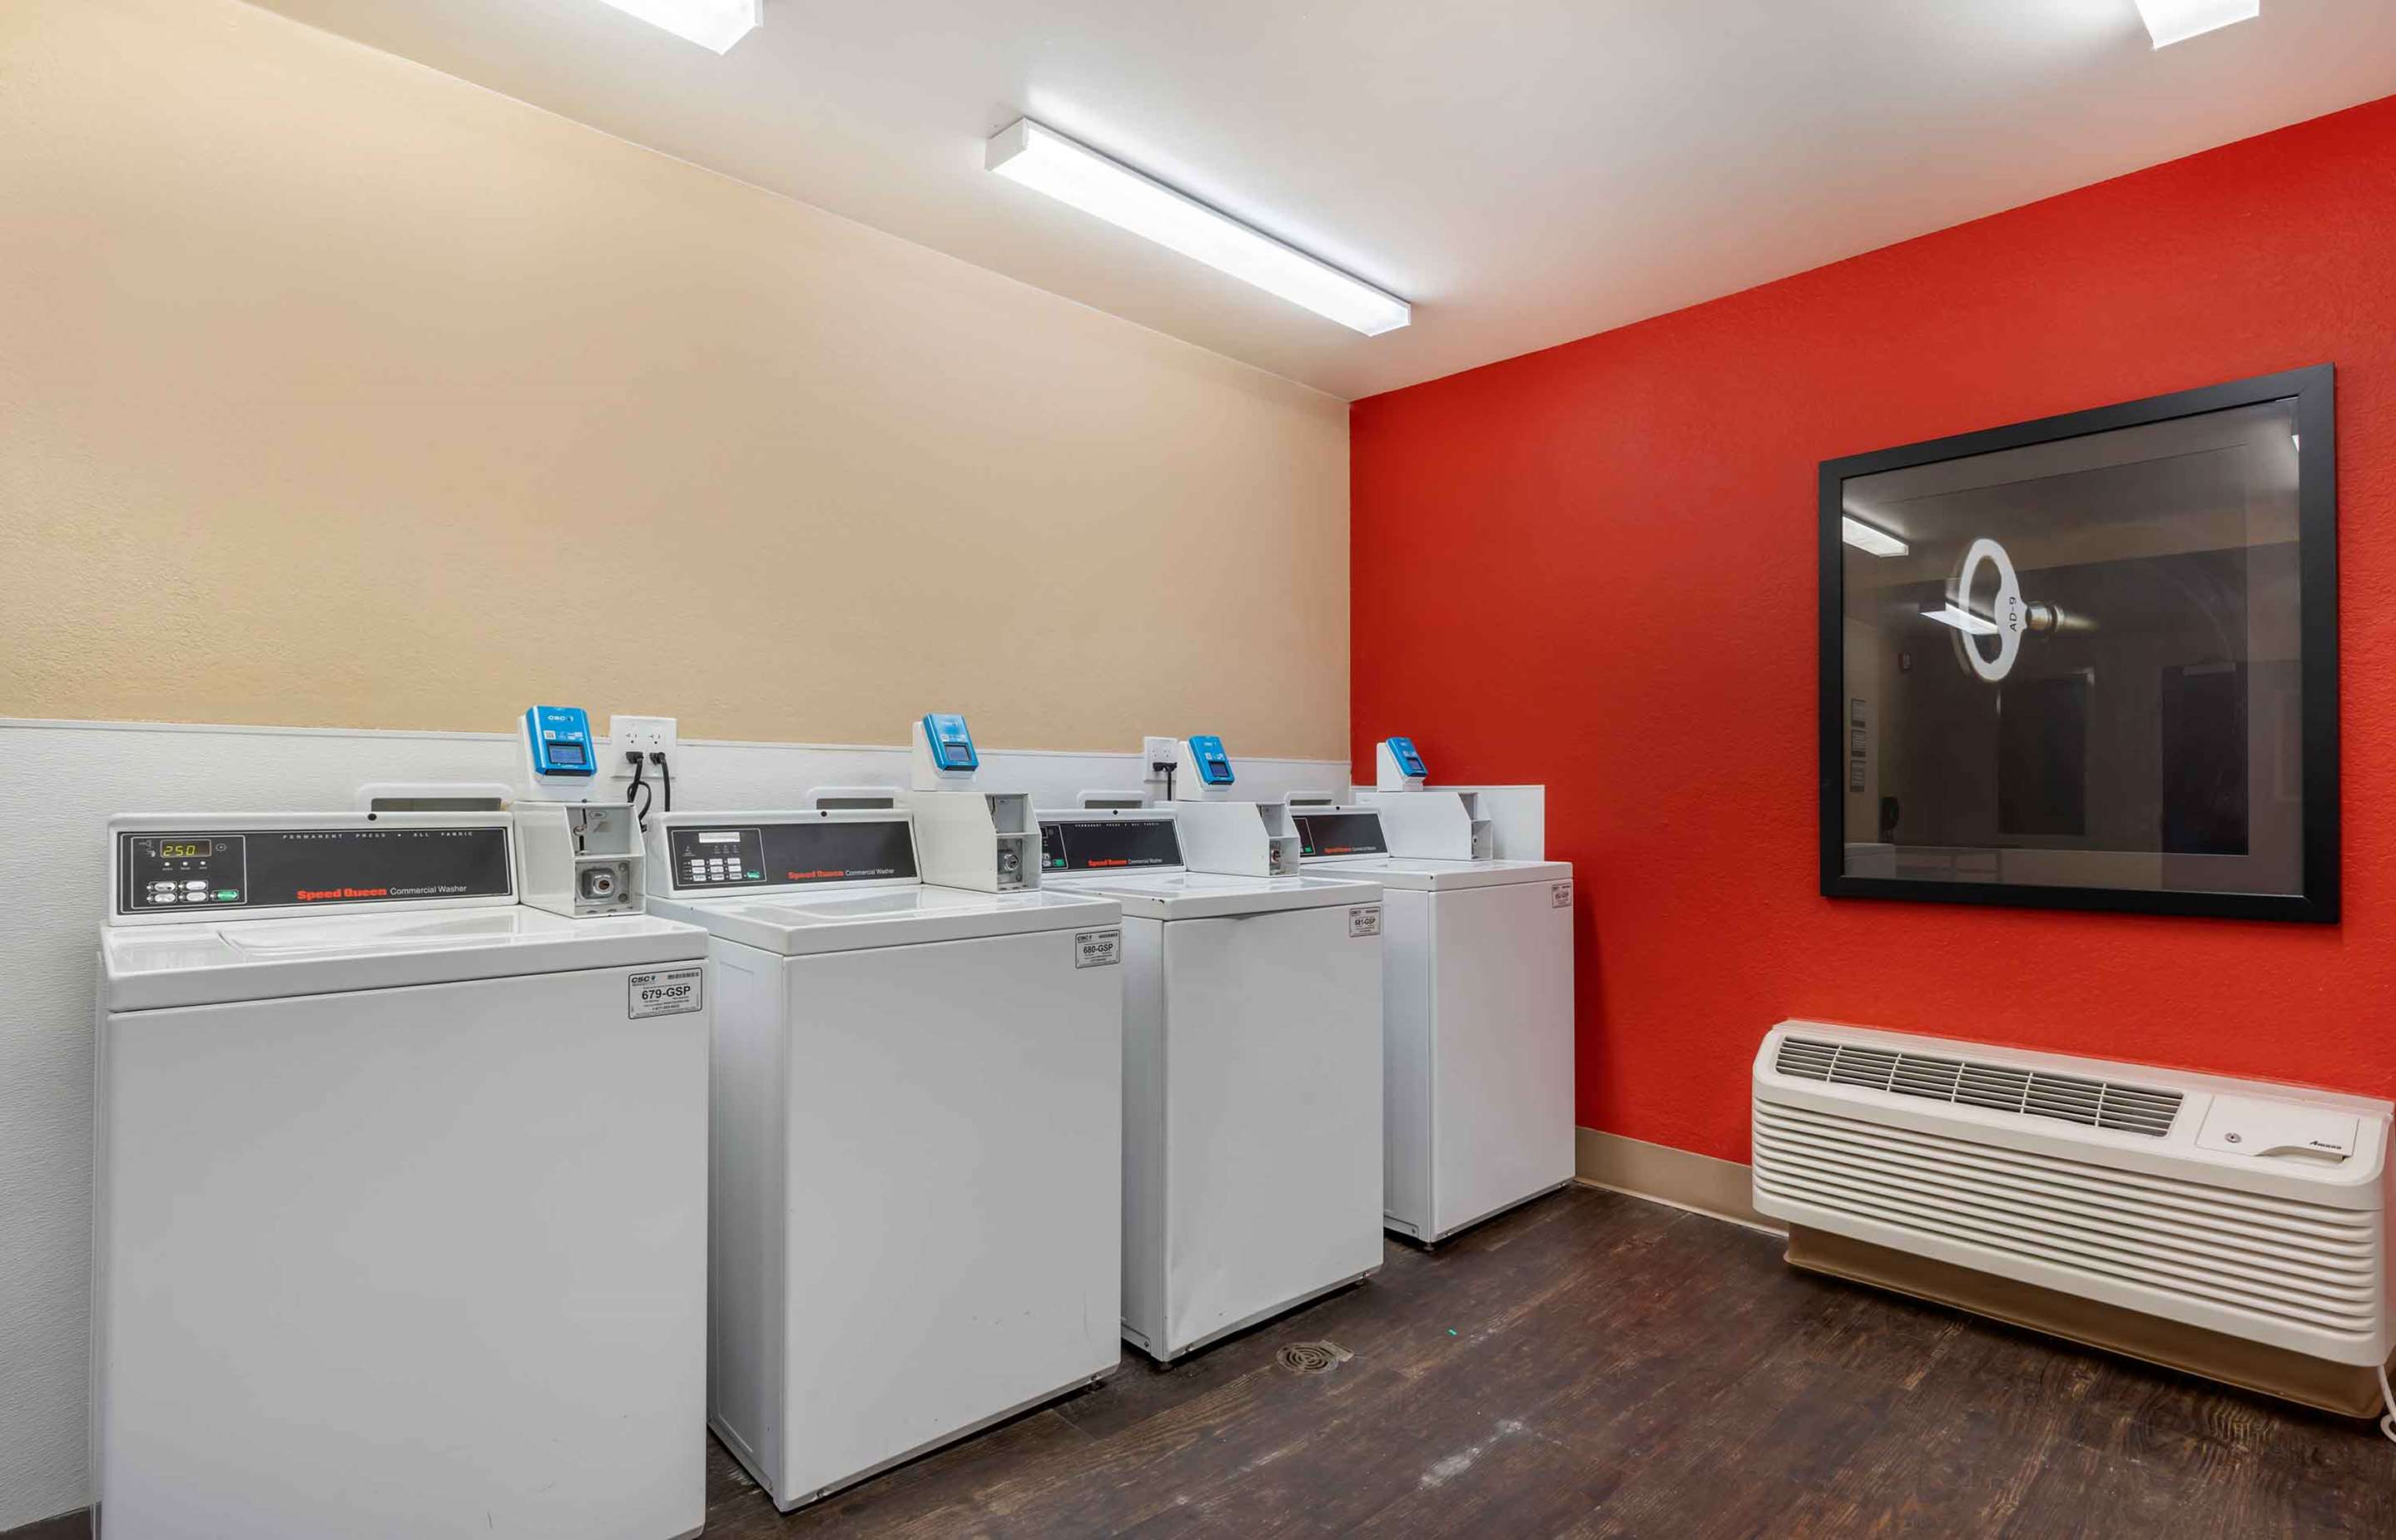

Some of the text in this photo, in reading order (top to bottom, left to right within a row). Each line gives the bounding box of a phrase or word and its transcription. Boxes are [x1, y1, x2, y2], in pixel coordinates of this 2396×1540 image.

[2008, 596, 2018, 632] AD-9
[163, 844, 196, 857] 250
[296, 885, 467, 900] Speed Queen Commercial Washer
[642, 986, 691, 1000] 679-GSP
